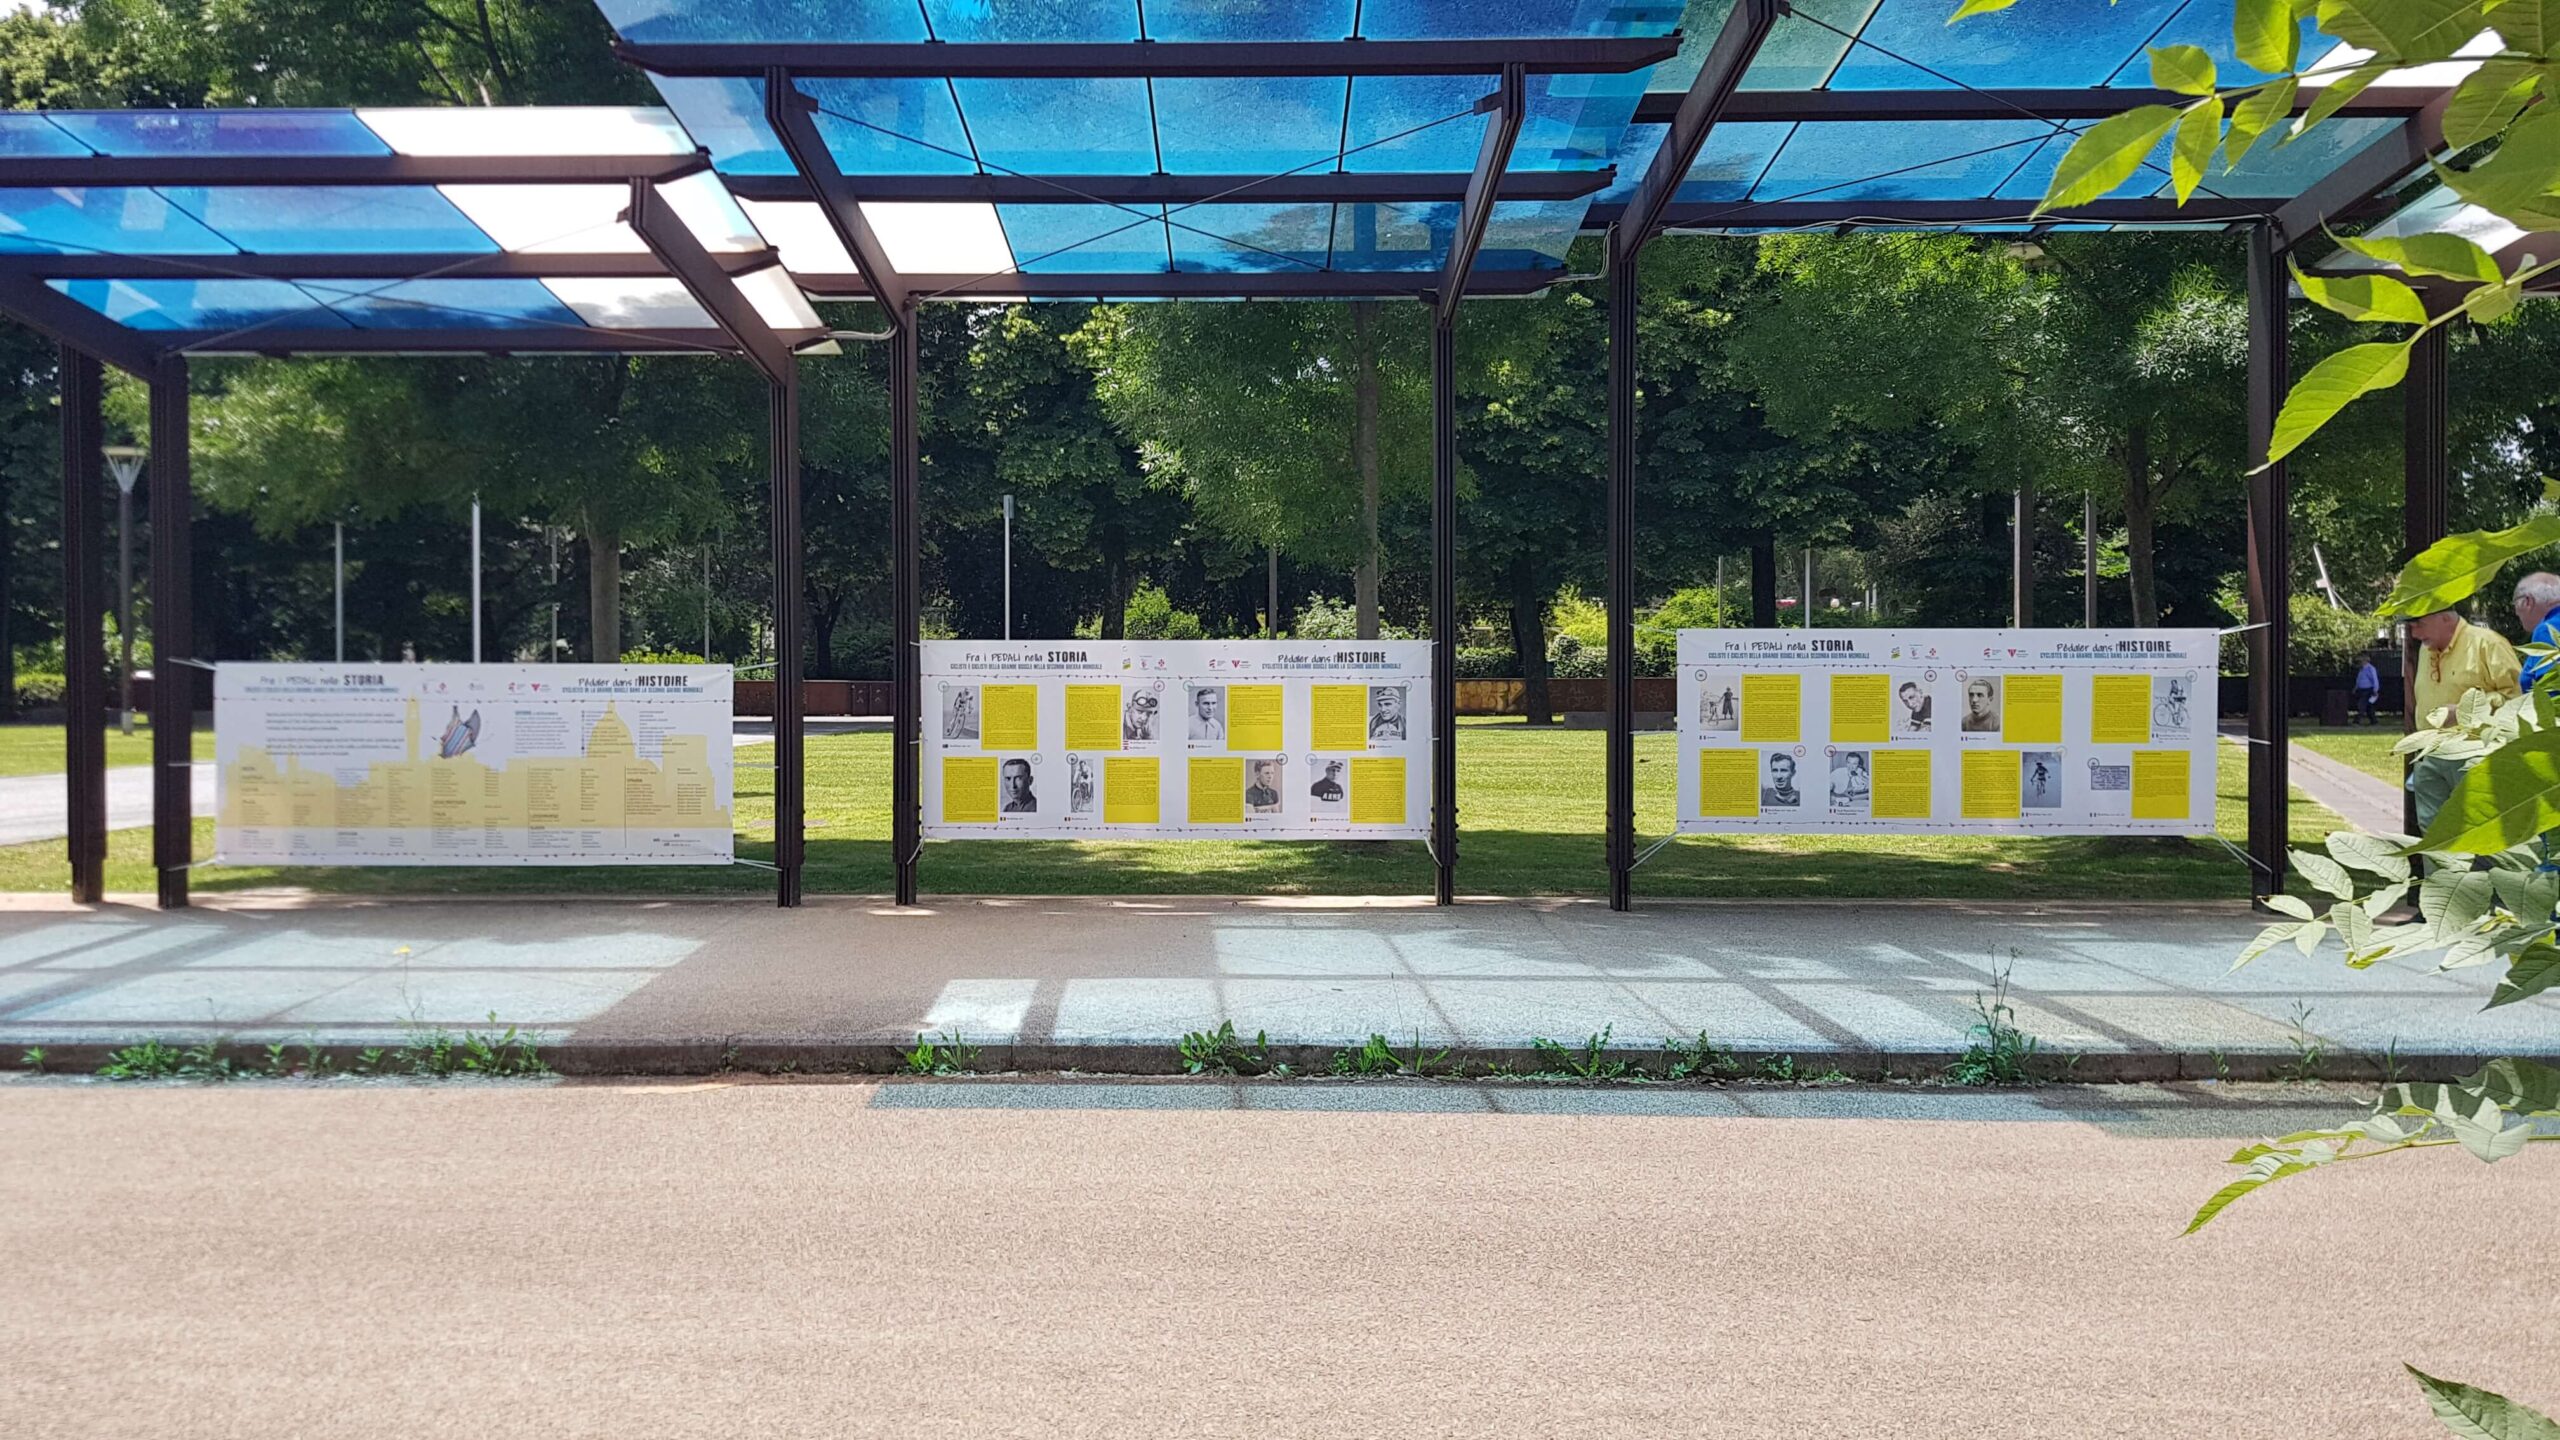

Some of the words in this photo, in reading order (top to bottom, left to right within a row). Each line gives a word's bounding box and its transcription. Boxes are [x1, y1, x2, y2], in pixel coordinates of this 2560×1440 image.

[1724, 642, 1740, 650] Fra
[1743, 642, 1747, 650] i
[1751, 642, 1783, 650] PEDALI
[1786, 642, 1806, 650] nella
[1811, 640, 1854, 651] STORIA
[2092, 643, 2113, 652] dans
[966, 653, 980, 662] Fra
[983, 653, 987, 662] i
[991, 653, 1021, 662] PEDALI
[1024, 653, 1043, 662] nella
[1048, 651, 1088, 662] STORIA
[1311, 654, 1331, 663] dans
[344, 675, 384, 686] STORIA
[612, 678, 632, 687] dans
